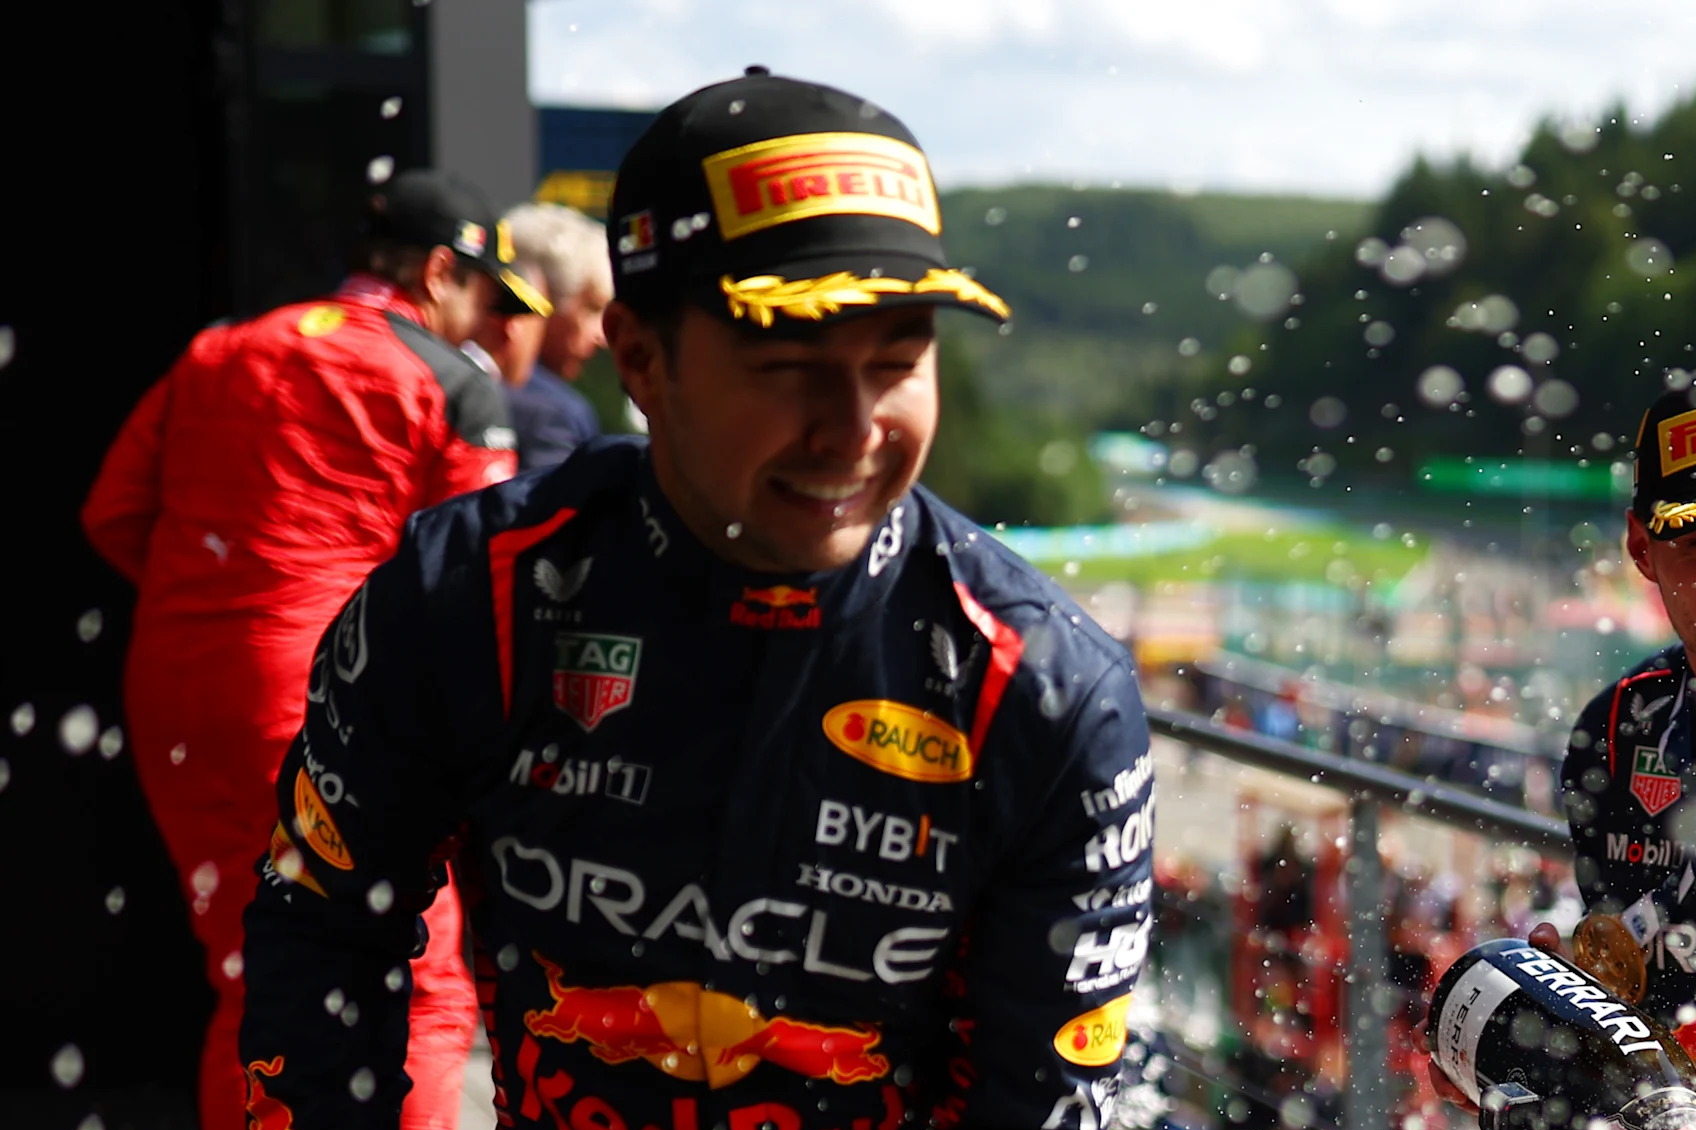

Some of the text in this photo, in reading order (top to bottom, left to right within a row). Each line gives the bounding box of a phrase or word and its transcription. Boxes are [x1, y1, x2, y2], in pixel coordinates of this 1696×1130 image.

[727, 150, 926, 217] PIRELLI
[866, 719, 961, 769] RAUCH
[814, 798, 959, 874] BYBIT
[1605, 831, 1672, 868] Mobil
[491, 836, 950, 985] ORACLE
[796, 863, 955, 913] HONDA
[1499, 946, 1665, 1057] FERRARI
